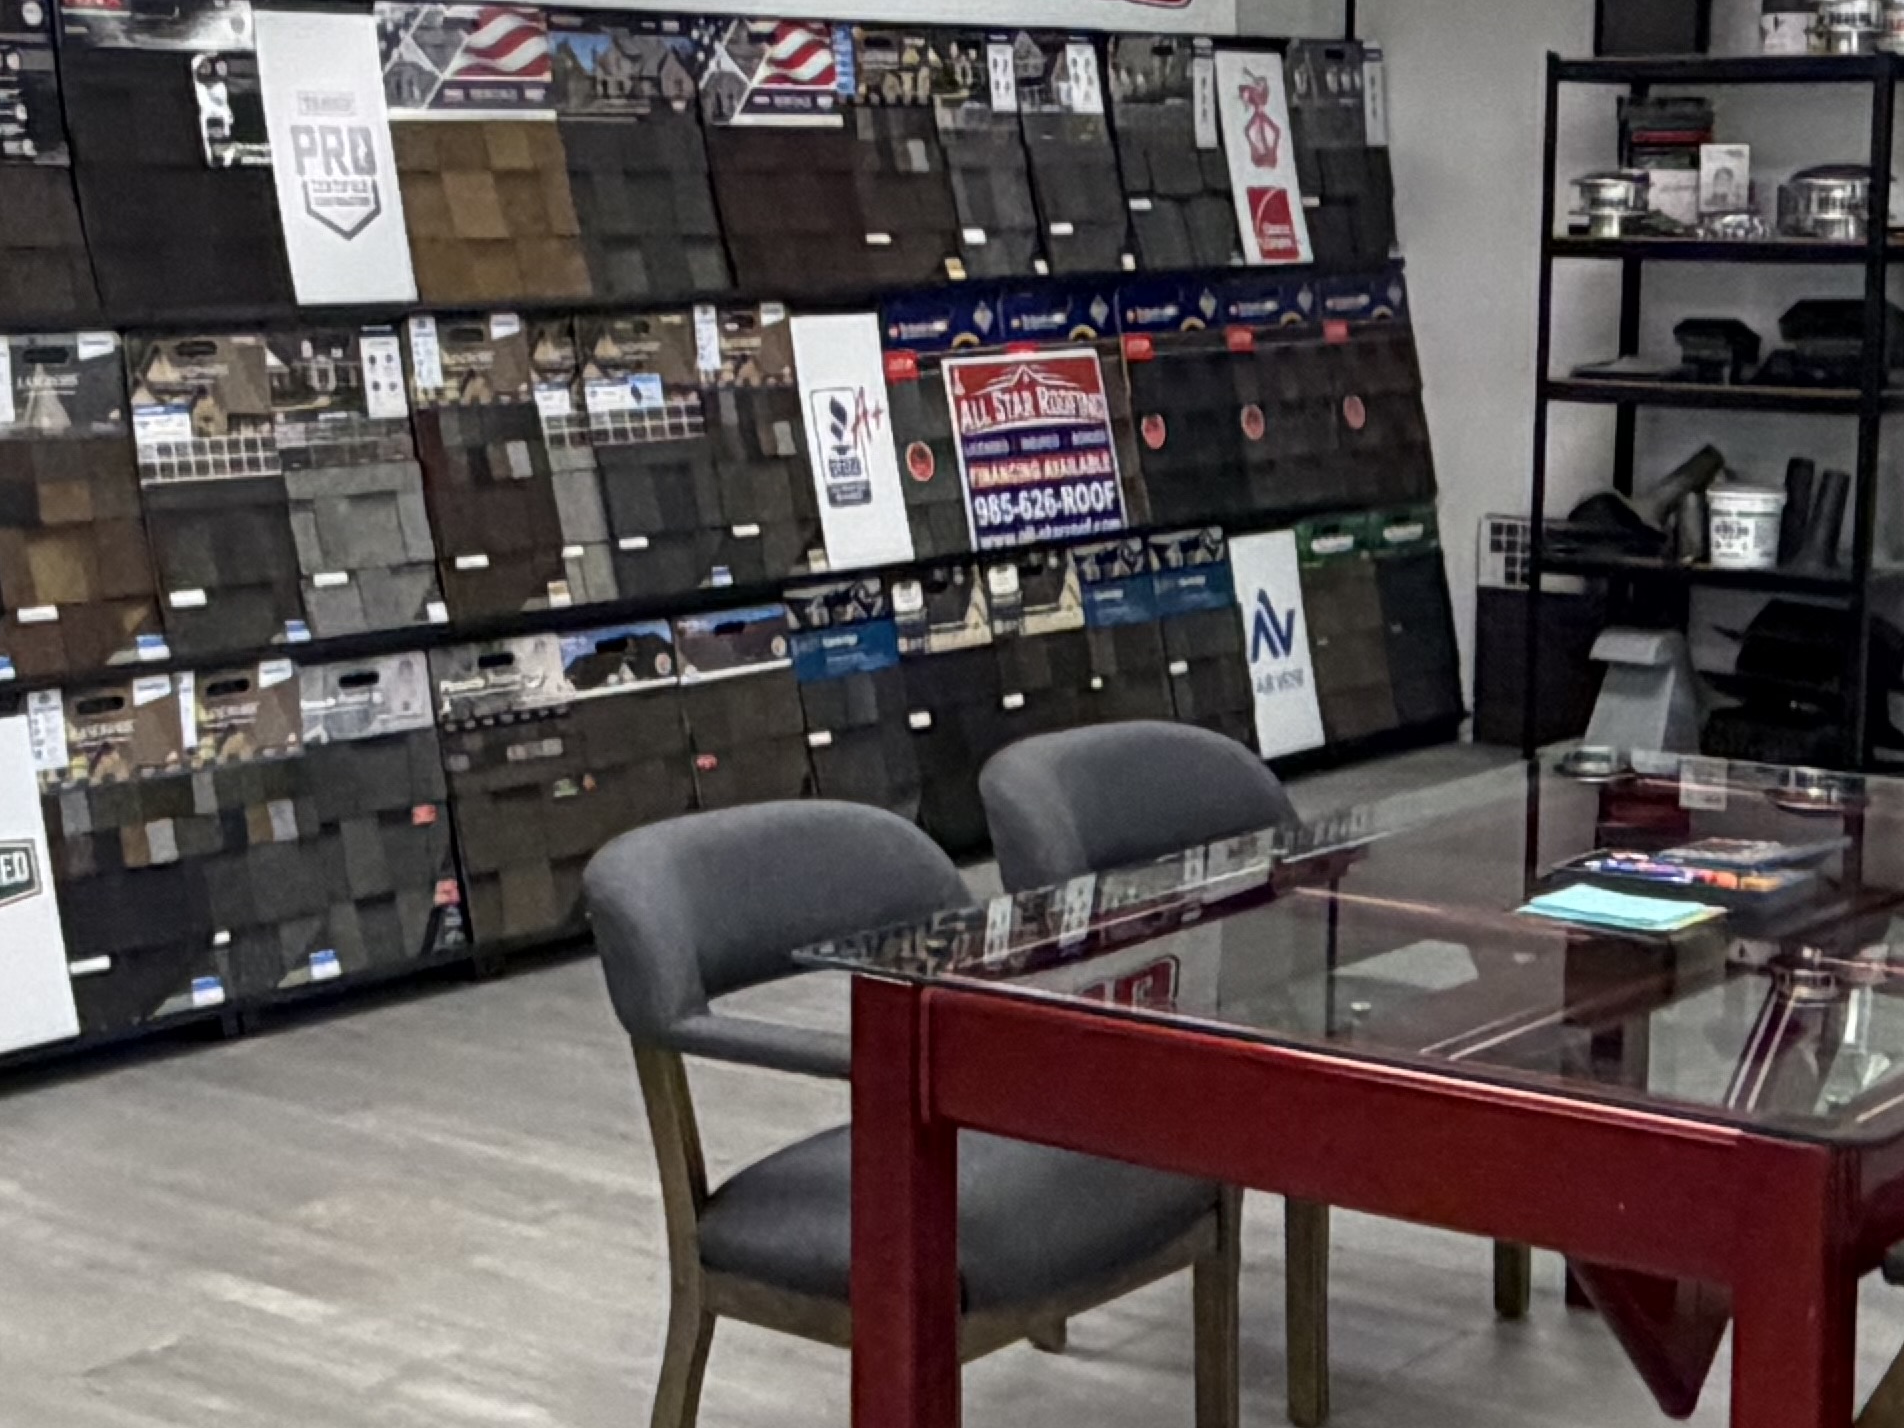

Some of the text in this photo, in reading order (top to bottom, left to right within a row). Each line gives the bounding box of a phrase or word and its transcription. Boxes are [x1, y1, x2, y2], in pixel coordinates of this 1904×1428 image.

[290, 124, 378, 177] PRO
[960, 386, 1106, 433] ALL STAR ROOFING
[1045, 448, 1112, 478] AVAILABLE
[974, 480, 1116, 527] 985-626-ROOF
